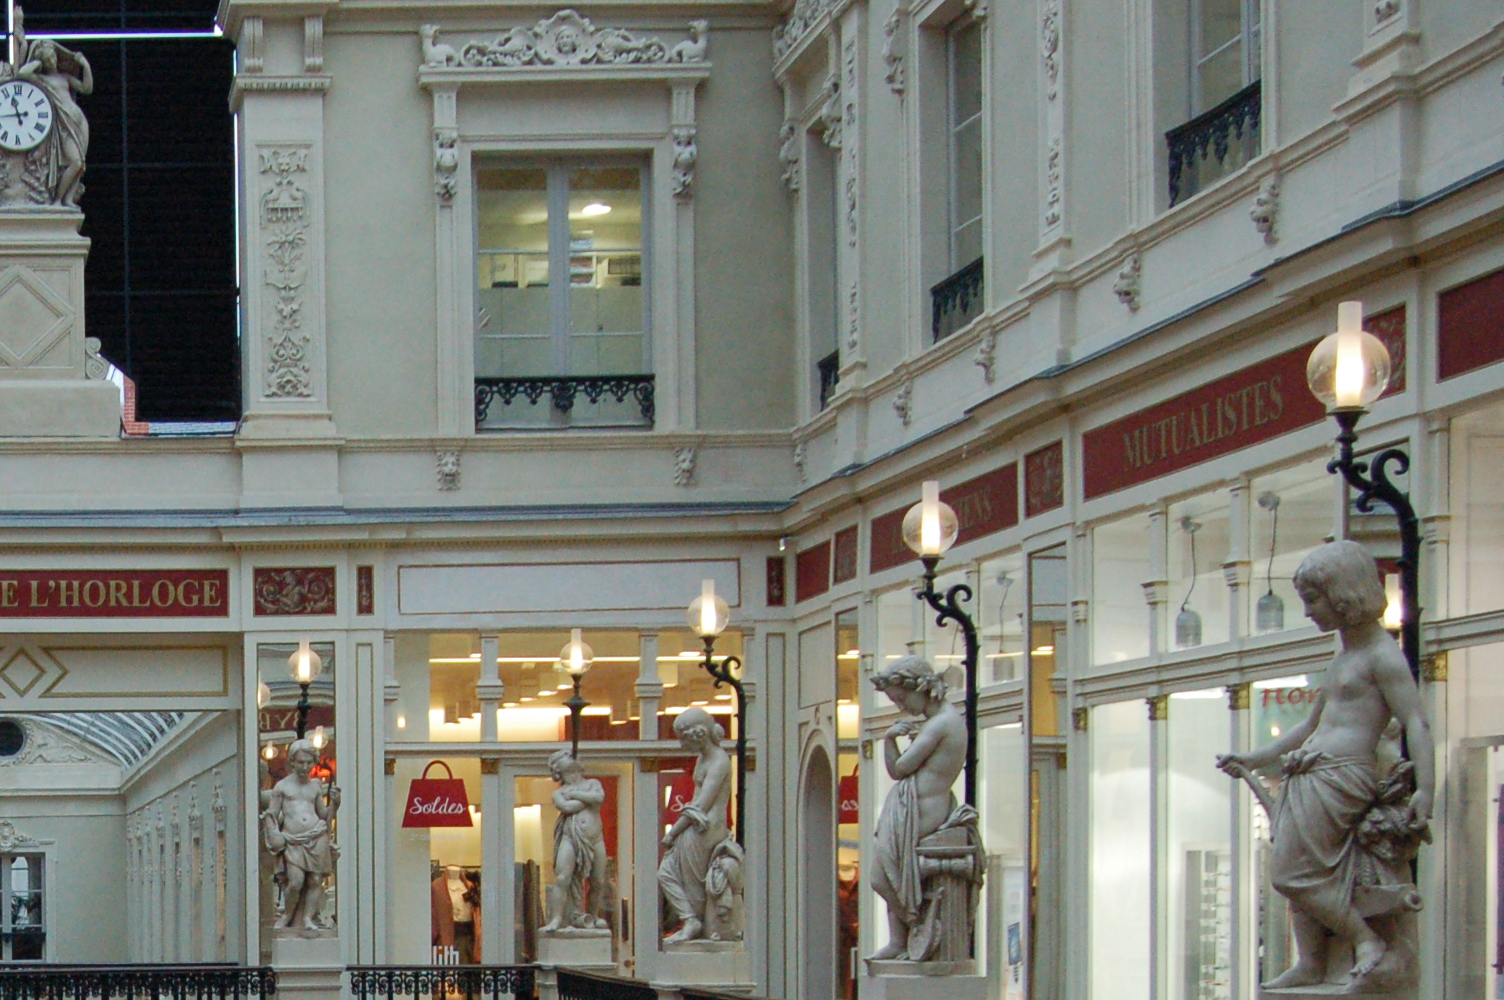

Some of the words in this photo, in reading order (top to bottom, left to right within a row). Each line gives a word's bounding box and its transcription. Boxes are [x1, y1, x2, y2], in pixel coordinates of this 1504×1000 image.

[1123, 376, 1284, 472] MUTUALISTES
[29, 579, 222, 608] L'HORLOGE
[410, 796, 467, 815] Soldes
